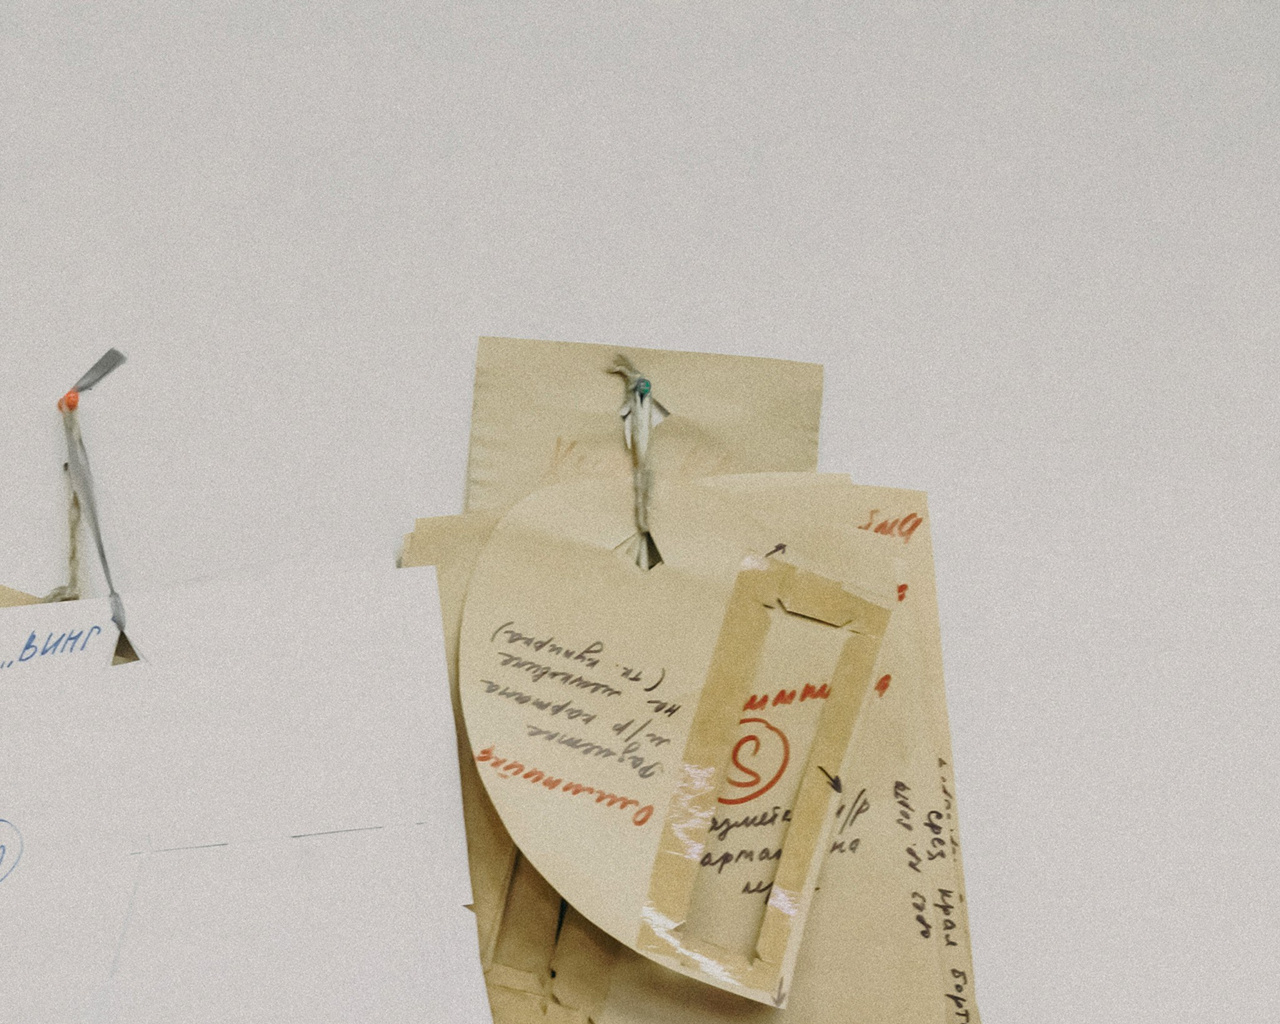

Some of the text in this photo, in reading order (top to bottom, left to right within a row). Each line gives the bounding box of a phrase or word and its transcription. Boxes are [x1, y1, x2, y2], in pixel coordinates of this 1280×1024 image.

[479, 679, 598, 725] кармана
[476, 745, 655, 826] Олимпийка
[726, 734, 761, 788] S
[923, 810, 946, 861] срез
